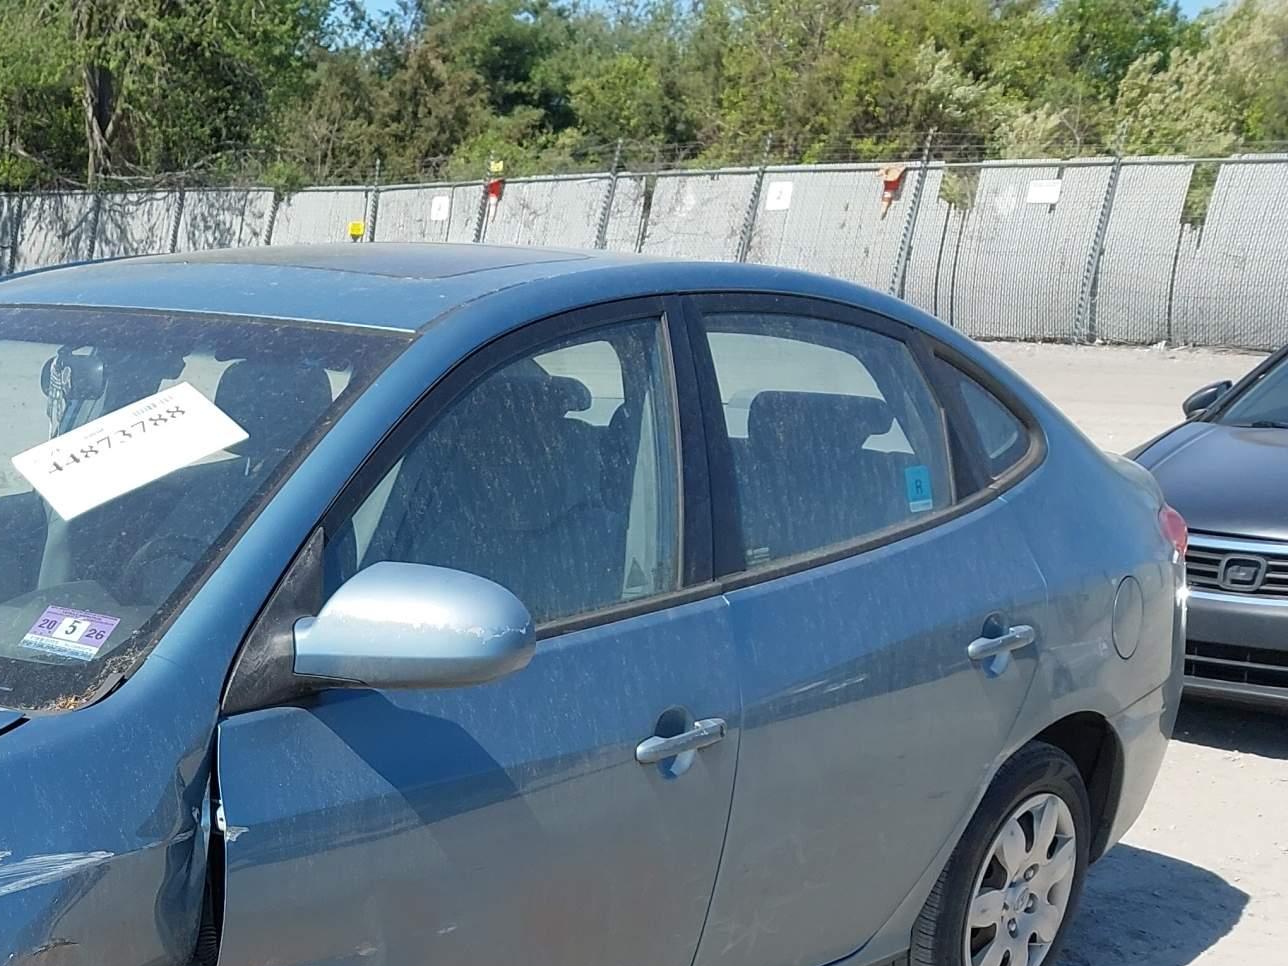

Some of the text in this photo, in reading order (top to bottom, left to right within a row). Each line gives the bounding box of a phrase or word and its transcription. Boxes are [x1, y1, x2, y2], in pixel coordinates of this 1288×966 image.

[37, 618, 107, 641] 20 5 26
